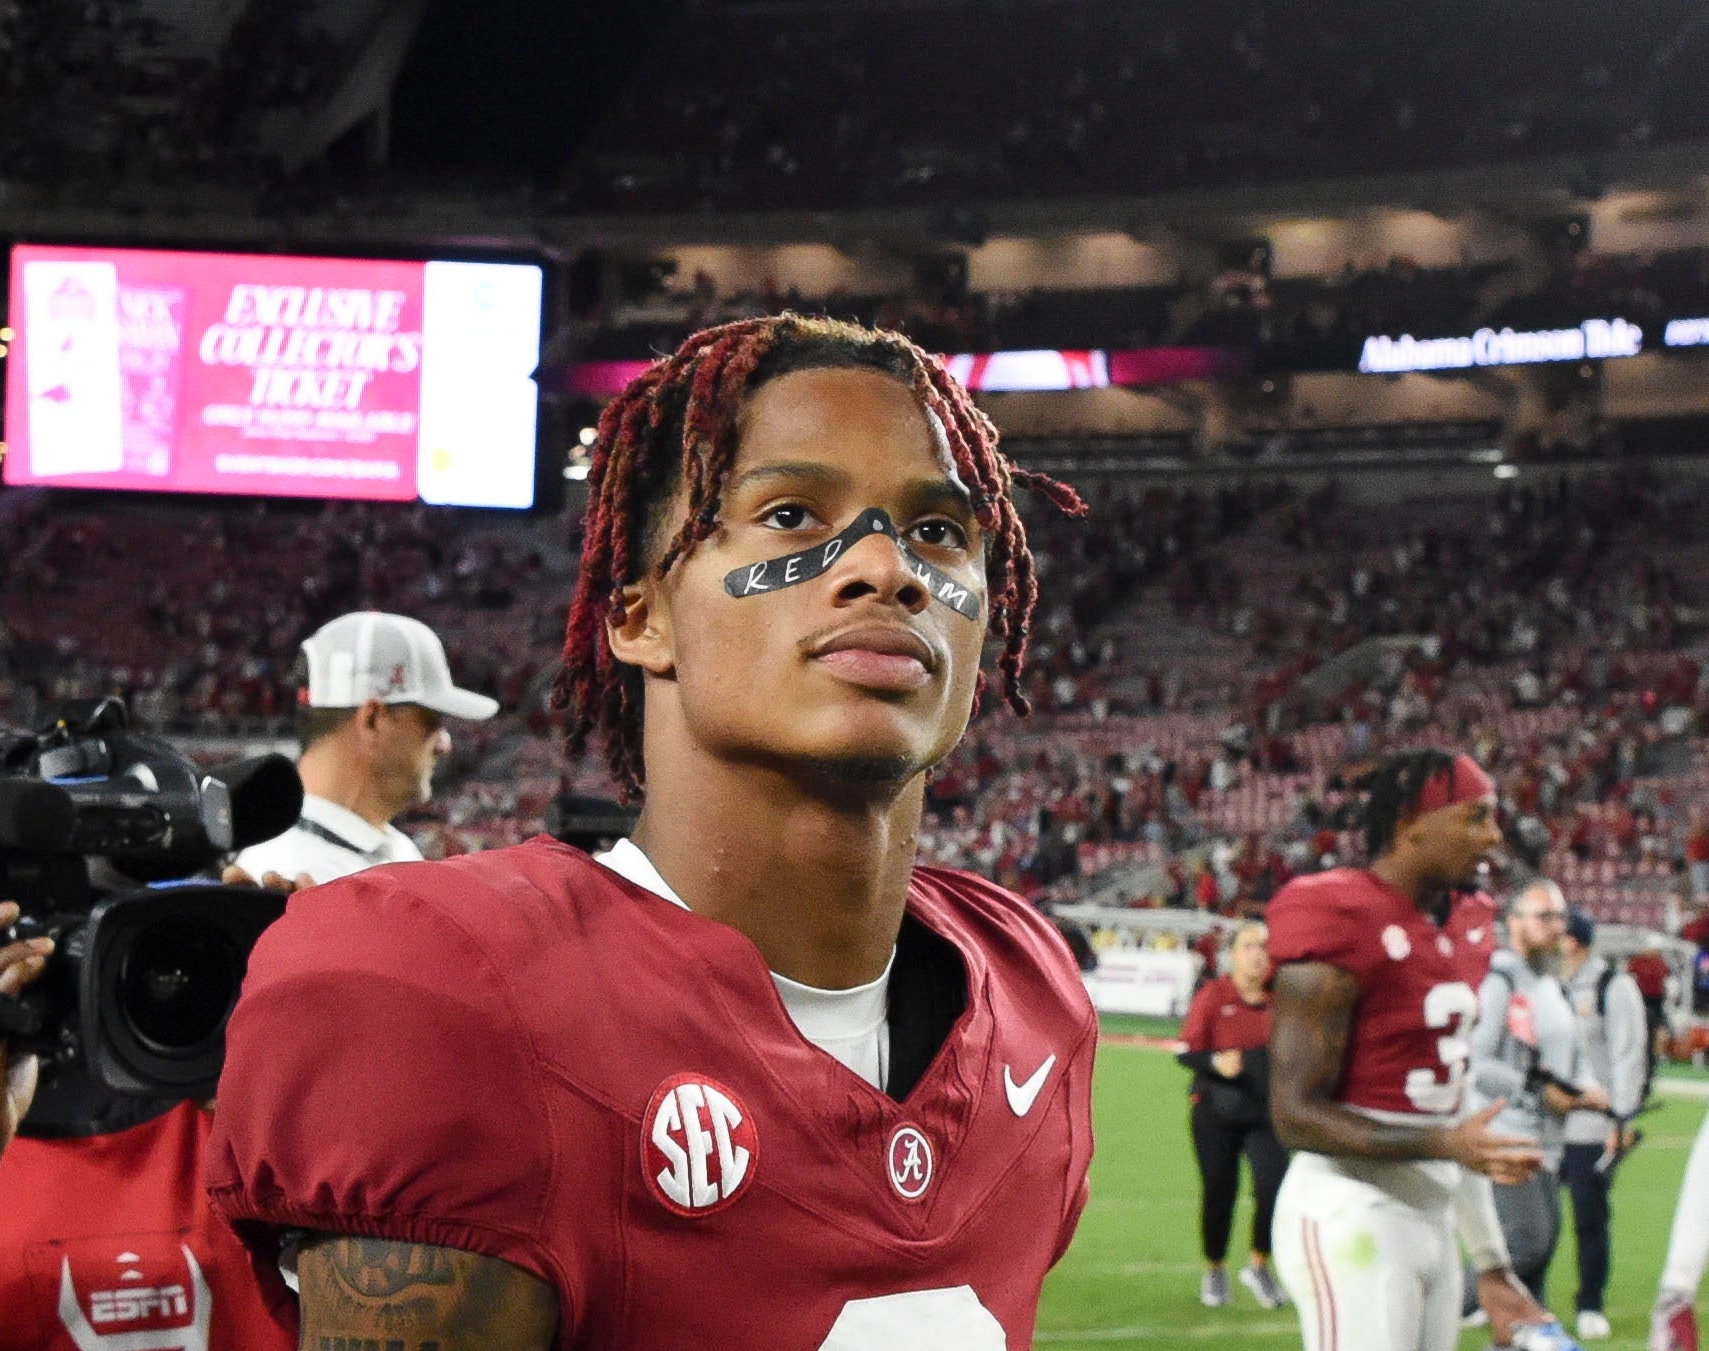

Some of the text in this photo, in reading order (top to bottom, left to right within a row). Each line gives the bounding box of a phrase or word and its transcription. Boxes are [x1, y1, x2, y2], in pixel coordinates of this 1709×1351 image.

[249, 366, 374, 410] TICKET
[743, 539, 843, 594] RED
[1404, 982, 1478, 1112] 3
[652, 1083, 750, 1208] SEC
[90, 1285, 188, 1322] ESPN
